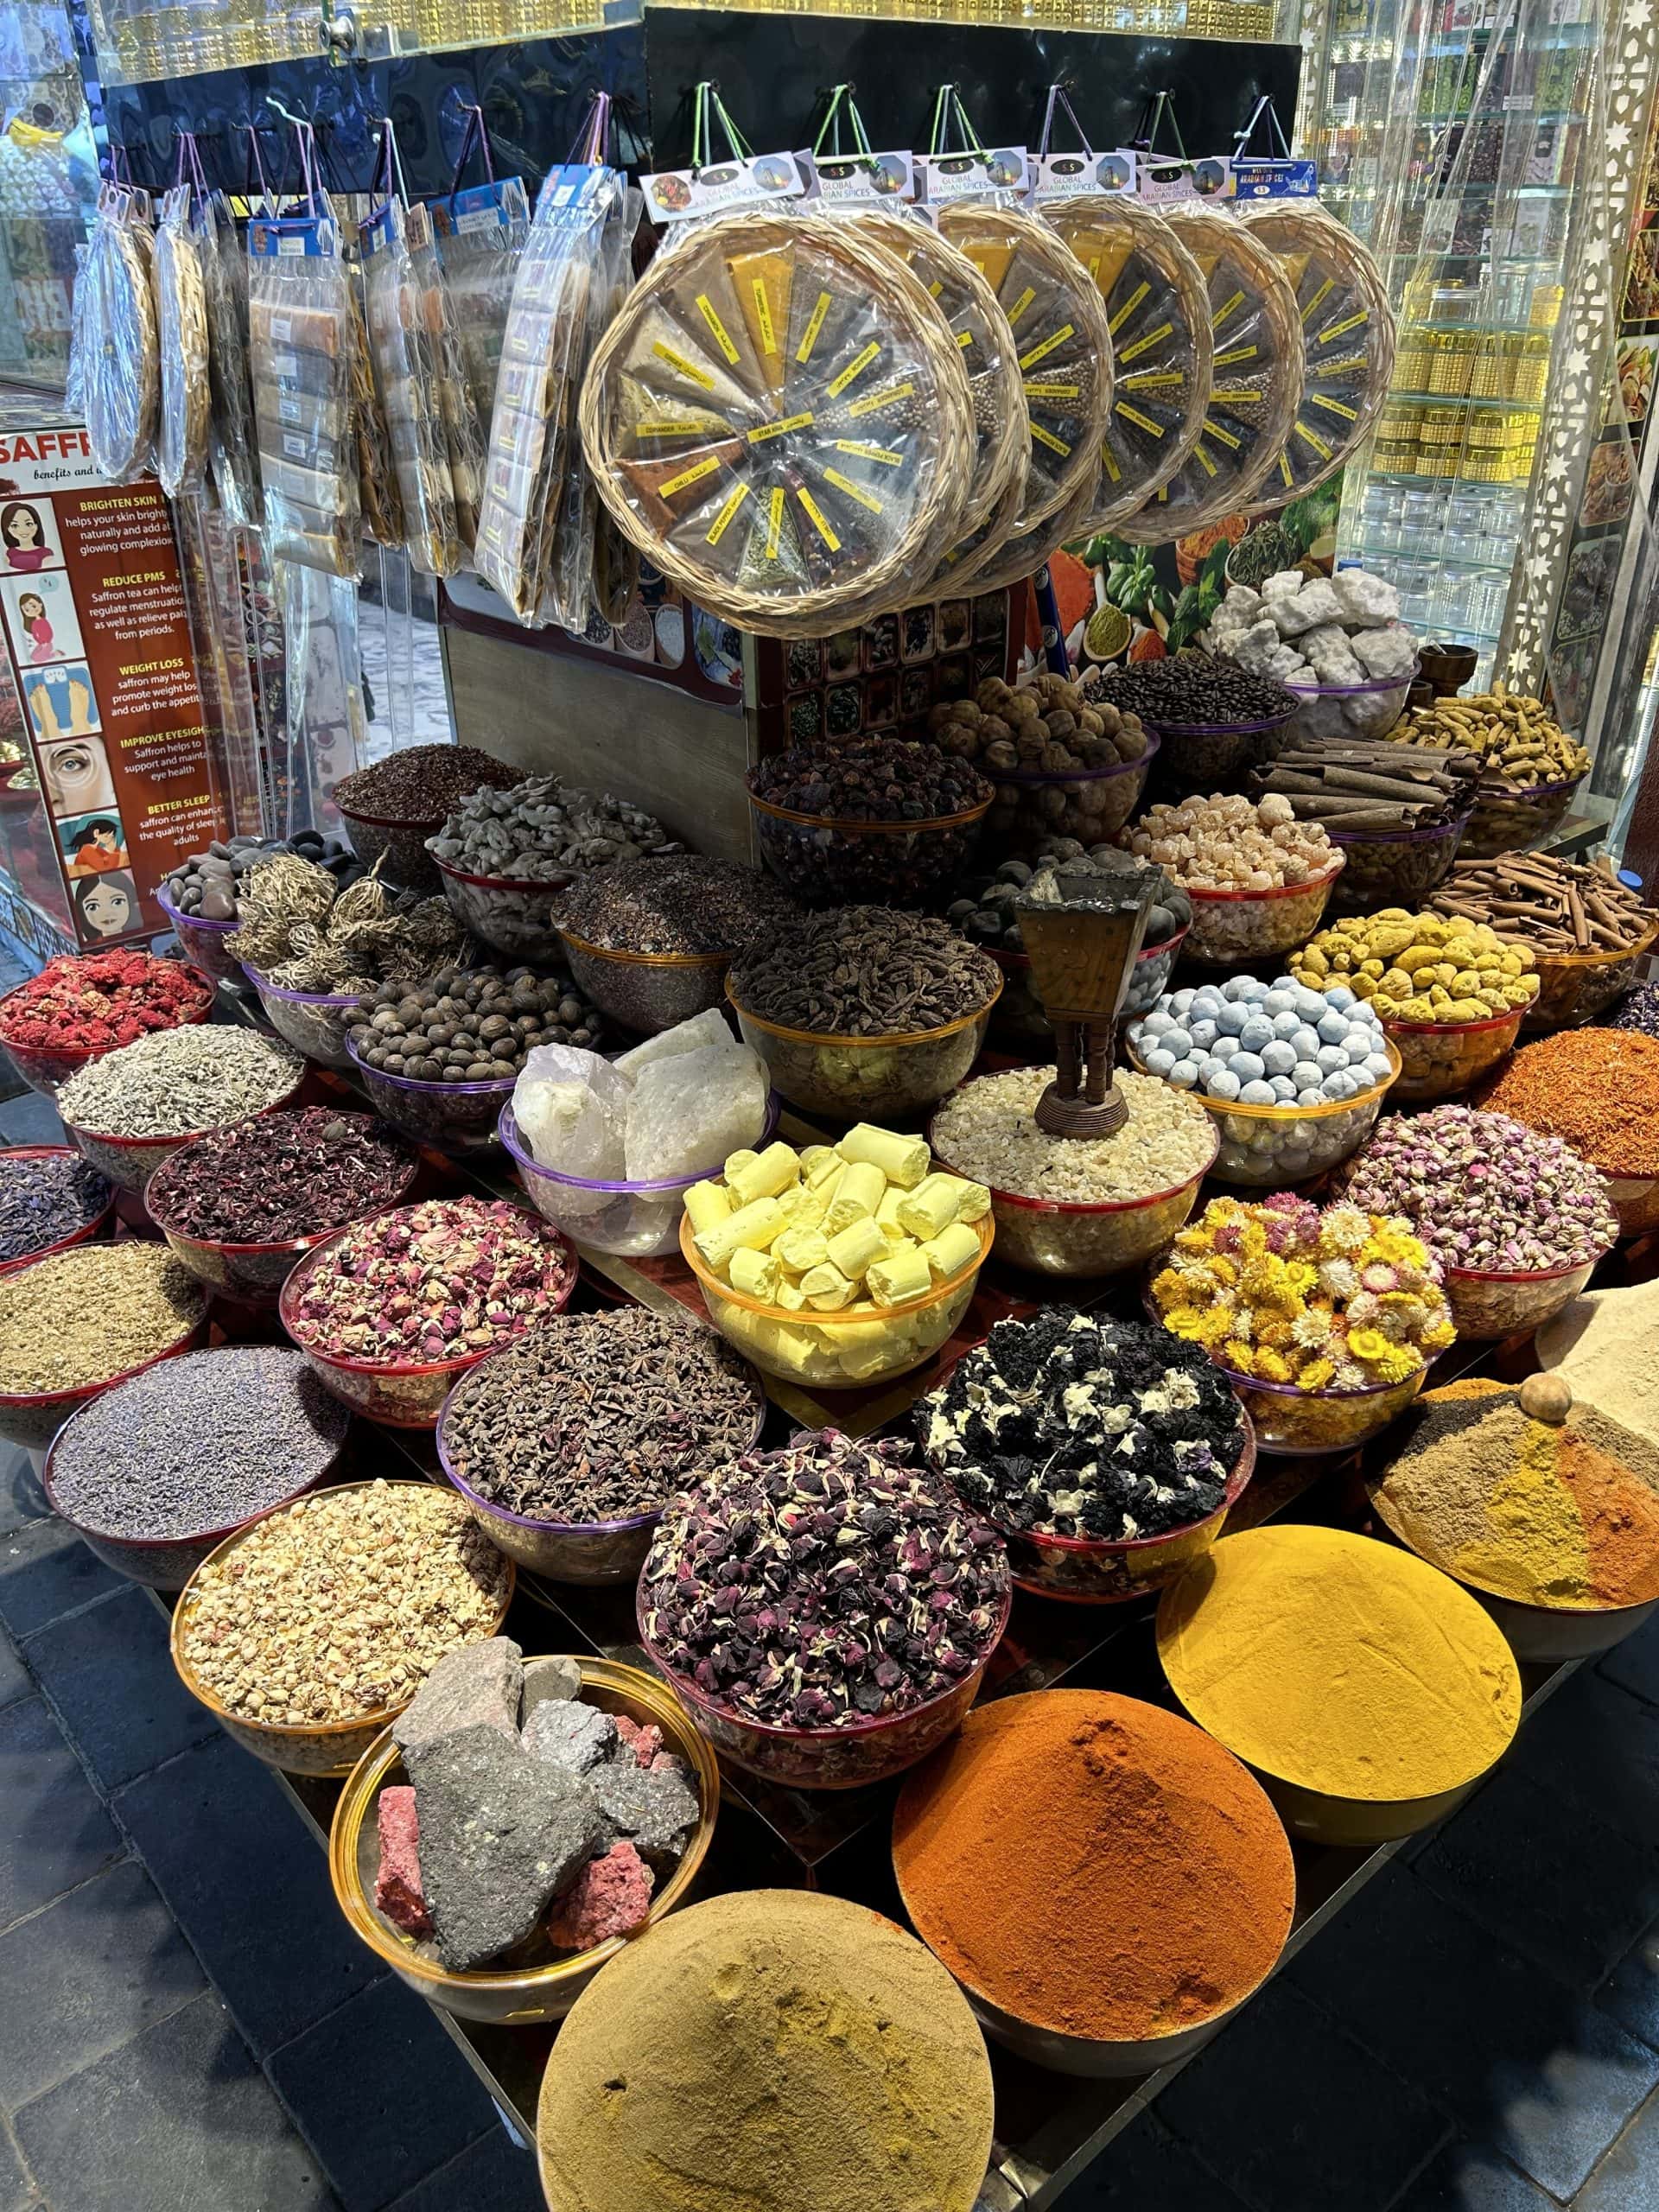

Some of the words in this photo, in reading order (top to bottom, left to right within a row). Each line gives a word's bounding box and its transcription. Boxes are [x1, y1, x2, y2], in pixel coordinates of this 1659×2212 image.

[1054, 175, 1081, 184] GLOBAL
[843, 188, 870, 199] SPICES
[34, 469, 71, 480] benefits
[74, 467, 93, 477] and
[79, 498, 131, 512] BRIGHTEN
[133, 495, 157, 506] SKIN
[65, 518, 91, 529] helps
[92, 516, 115, 527] your
[116, 512, 136, 522] skin
[709, 524, 721, 541] BLACK
[718, 506, 732, 525] PEPPER
[79, 526, 121, 540] naturally
[123, 524, 141, 535] and
[143, 523, 161, 532] add
[79, 543, 118, 556] glowing
[103, 574, 143, 588] REDUCE
[144, 571, 166, 582] PMS
[92, 592, 125, 603] Saffron
[127, 589, 141, 598] tea
[143, 588, 159, 596] can
[89, 605, 129, 618] regulate
[105, 617, 125, 628] well
[126, 617, 137, 626] as
[138, 611, 168, 624] relieve
[115, 630, 137, 640] from
[139, 624, 175, 639] periods.
[119, 662, 158, 676] WEIGHT
[160, 658, 184, 670] LOSS
[118, 678, 149, 690] saffron
[150, 676, 169, 685] may
[171, 670, 191, 681] help
[111, 691, 151, 705] promote
[152, 684, 182, 696] weight
[111, 706, 129, 717] and
[130, 702, 151, 713] curb
[152, 699, 167, 709] the
[120, 733, 164, 749] IMPROVE
[134, 746, 166, 759] Saffron
[167, 742, 190, 753] helps
[124, 760, 159, 773] support
[160, 756, 178, 766] and
[151, 772, 167, 781] eye
[168, 766, 195, 778] health
[148, 800, 182, 815] BETTER
[183, 794, 211, 808] SLEEP
[139, 817, 169, 830] saffron
[170, 812, 186, 822] can
[139, 831, 154, 842] the
[156, 826, 185, 839] quality
[187, 823, 195, 832] of
[173, 835, 200, 846] adults
